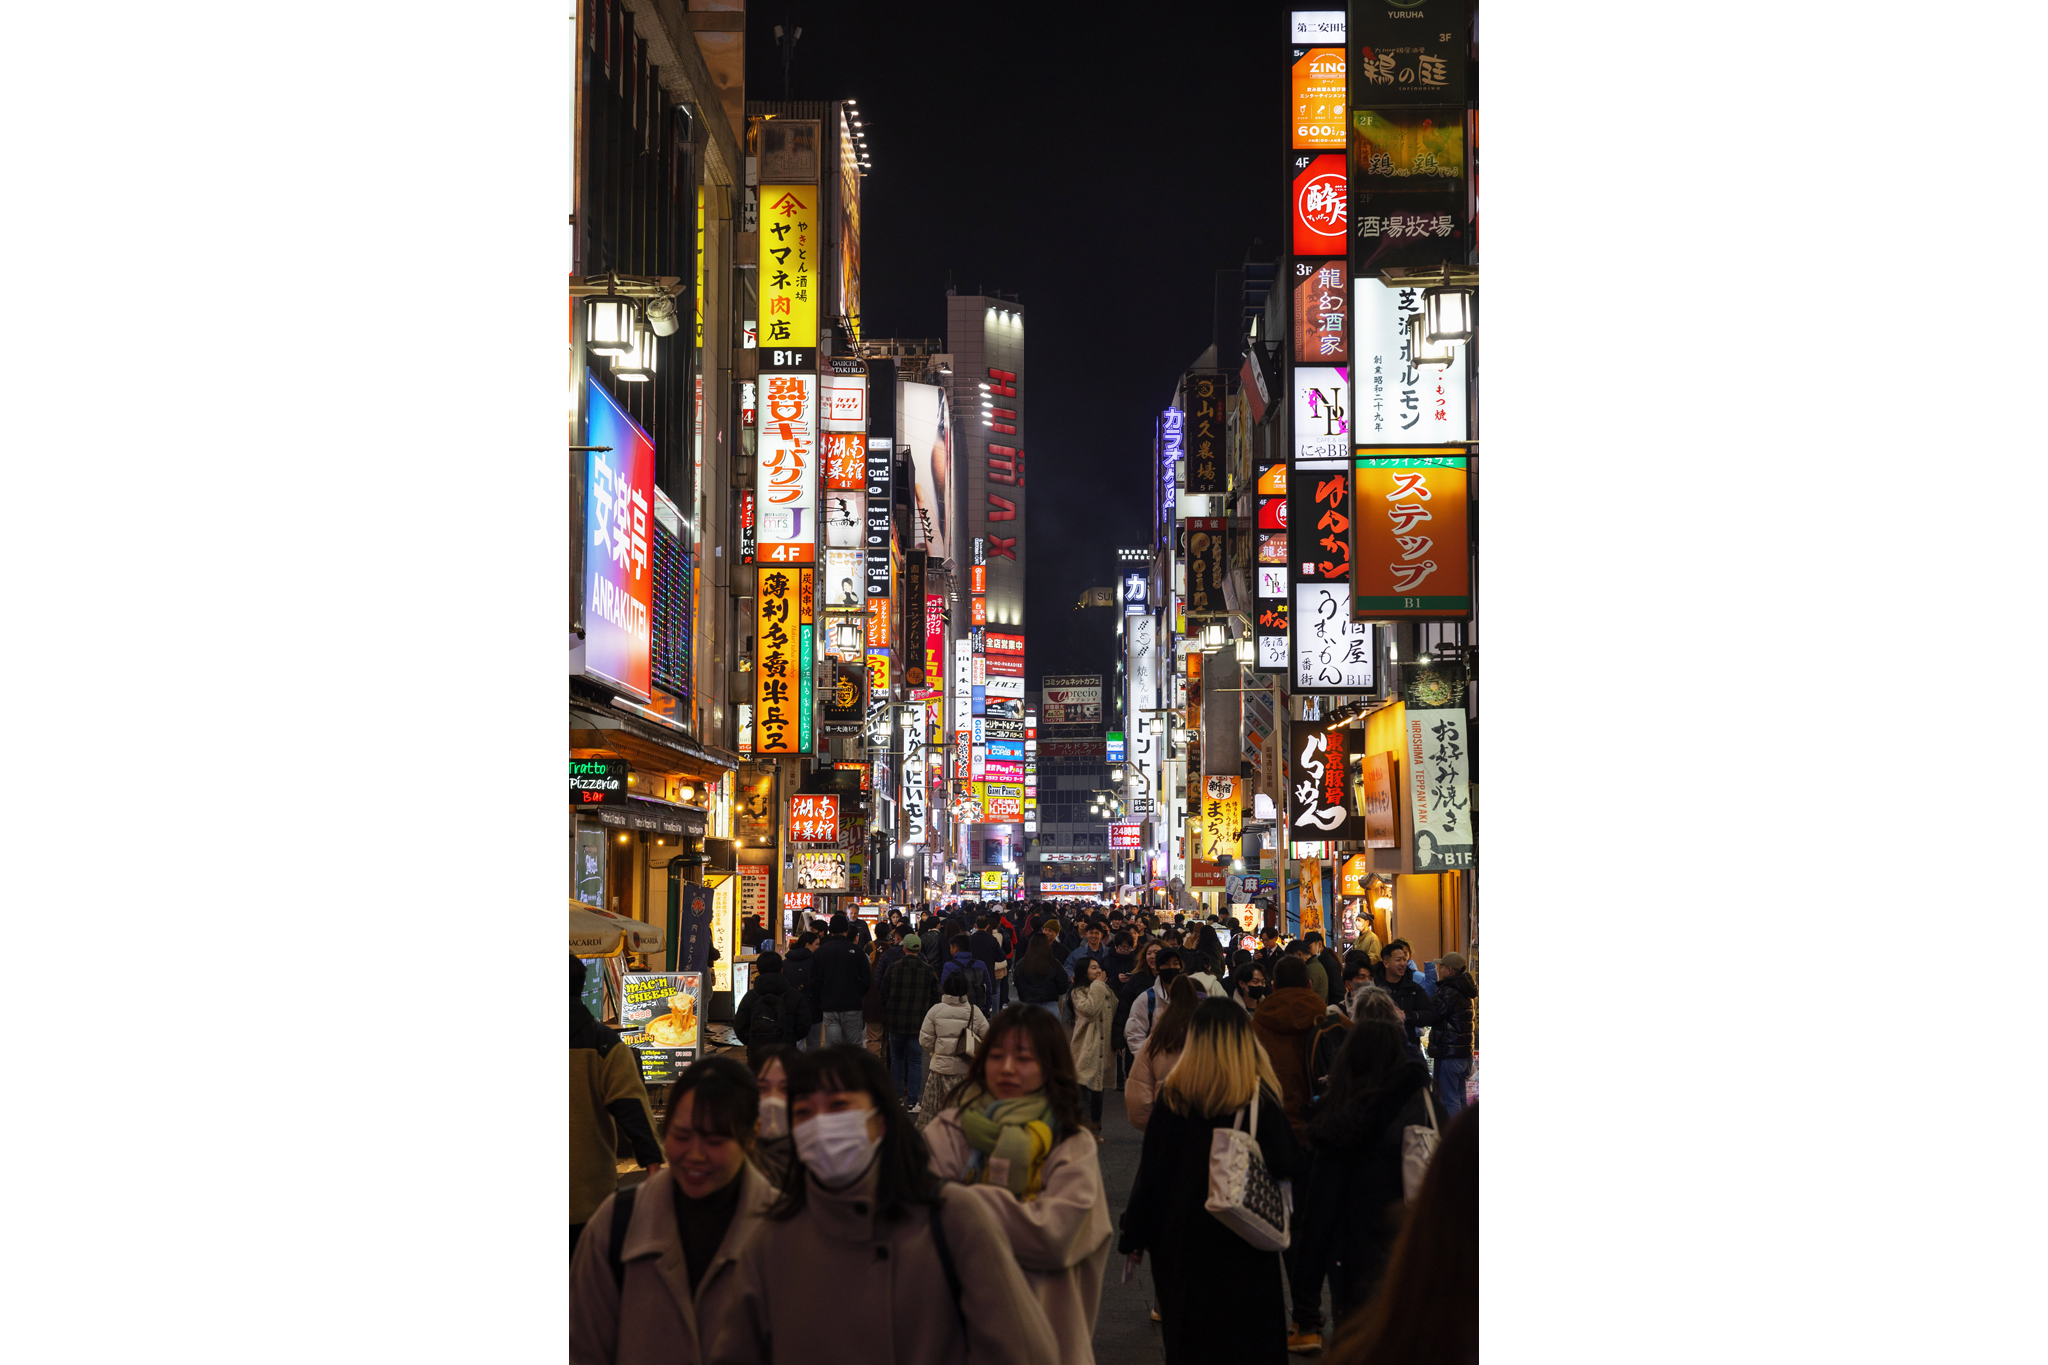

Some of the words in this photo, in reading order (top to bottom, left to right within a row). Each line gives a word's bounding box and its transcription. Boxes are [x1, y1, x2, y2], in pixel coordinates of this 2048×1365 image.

[1439, 33, 1452, 42] 3F
[1360, 116, 1373, 126] 2F
[1298, 126, 1331, 137] 600
[1295, 157, 1310, 168] 4F
[1360, 194, 1373, 203] 2F
[1358, 215, 1455, 238] 酒場牧場
[795, 221, 808, 303] やきとん酒場
[1296, 264, 1313, 276] 3F
[767, 222, 792, 342] ヤマネ肉店
[1318, 268, 1344, 356] 龍幻酒家
[773, 350, 803, 366] B1F
[1373, 355, 1384, 433] 創業昭和二十九年
[762, 377, 814, 504] 熟女キャバクラ
[1196, 400, 1216, 481] 山久農場
[1368, 457, 1455, 467] オンラインカフェ
[839, 480, 853, 488] 4F
[594, 453, 648, 580] 安楽亭
[1194, 519, 1219, 529] 麻雀
[1386, 471, 1438, 593] ステップ
[771, 545, 801, 561] 4F
[801, 573, 812, 617] 炭火串焼
[1404, 598, 1421, 608] B1
[592, 572, 646, 641] ANRAKUTEI
[1314, 590, 1343, 685] うまいもん
[1341, 597, 1368, 664] 酒屋
[986, 638, 1023, 651] 全店営業中
[1301, 650, 1313, 686] 一番街
[1346, 674, 1371, 685] B1F
[1411, 720, 1423, 765] HIROSHIMA
[569, 761, 623, 775] Trattoria
[906, 708, 924, 835] とんかにいむら
[1265, 746, 1273, 788] 劇場通り一番街
[1324, 731, 1345, 805] 東京豚骨
[570, 776, 619, 790] Pizzeria
[1429, 719, 1468, 833] お好み焼き
[1209, 781, 1231, 794] 新宿
[582, 791, 605, 802] Bar
[1113, 827, 1140, 836] 24時間
[1207, 801, 1225, 855] まっちゃん
[1113, 837, 1140, 846] 営業中
[1445, 852, 1473, 865] B1F
[627, 987, 678, 1003] CHEESE
[629, 1010, 652, 1020] ¥900
